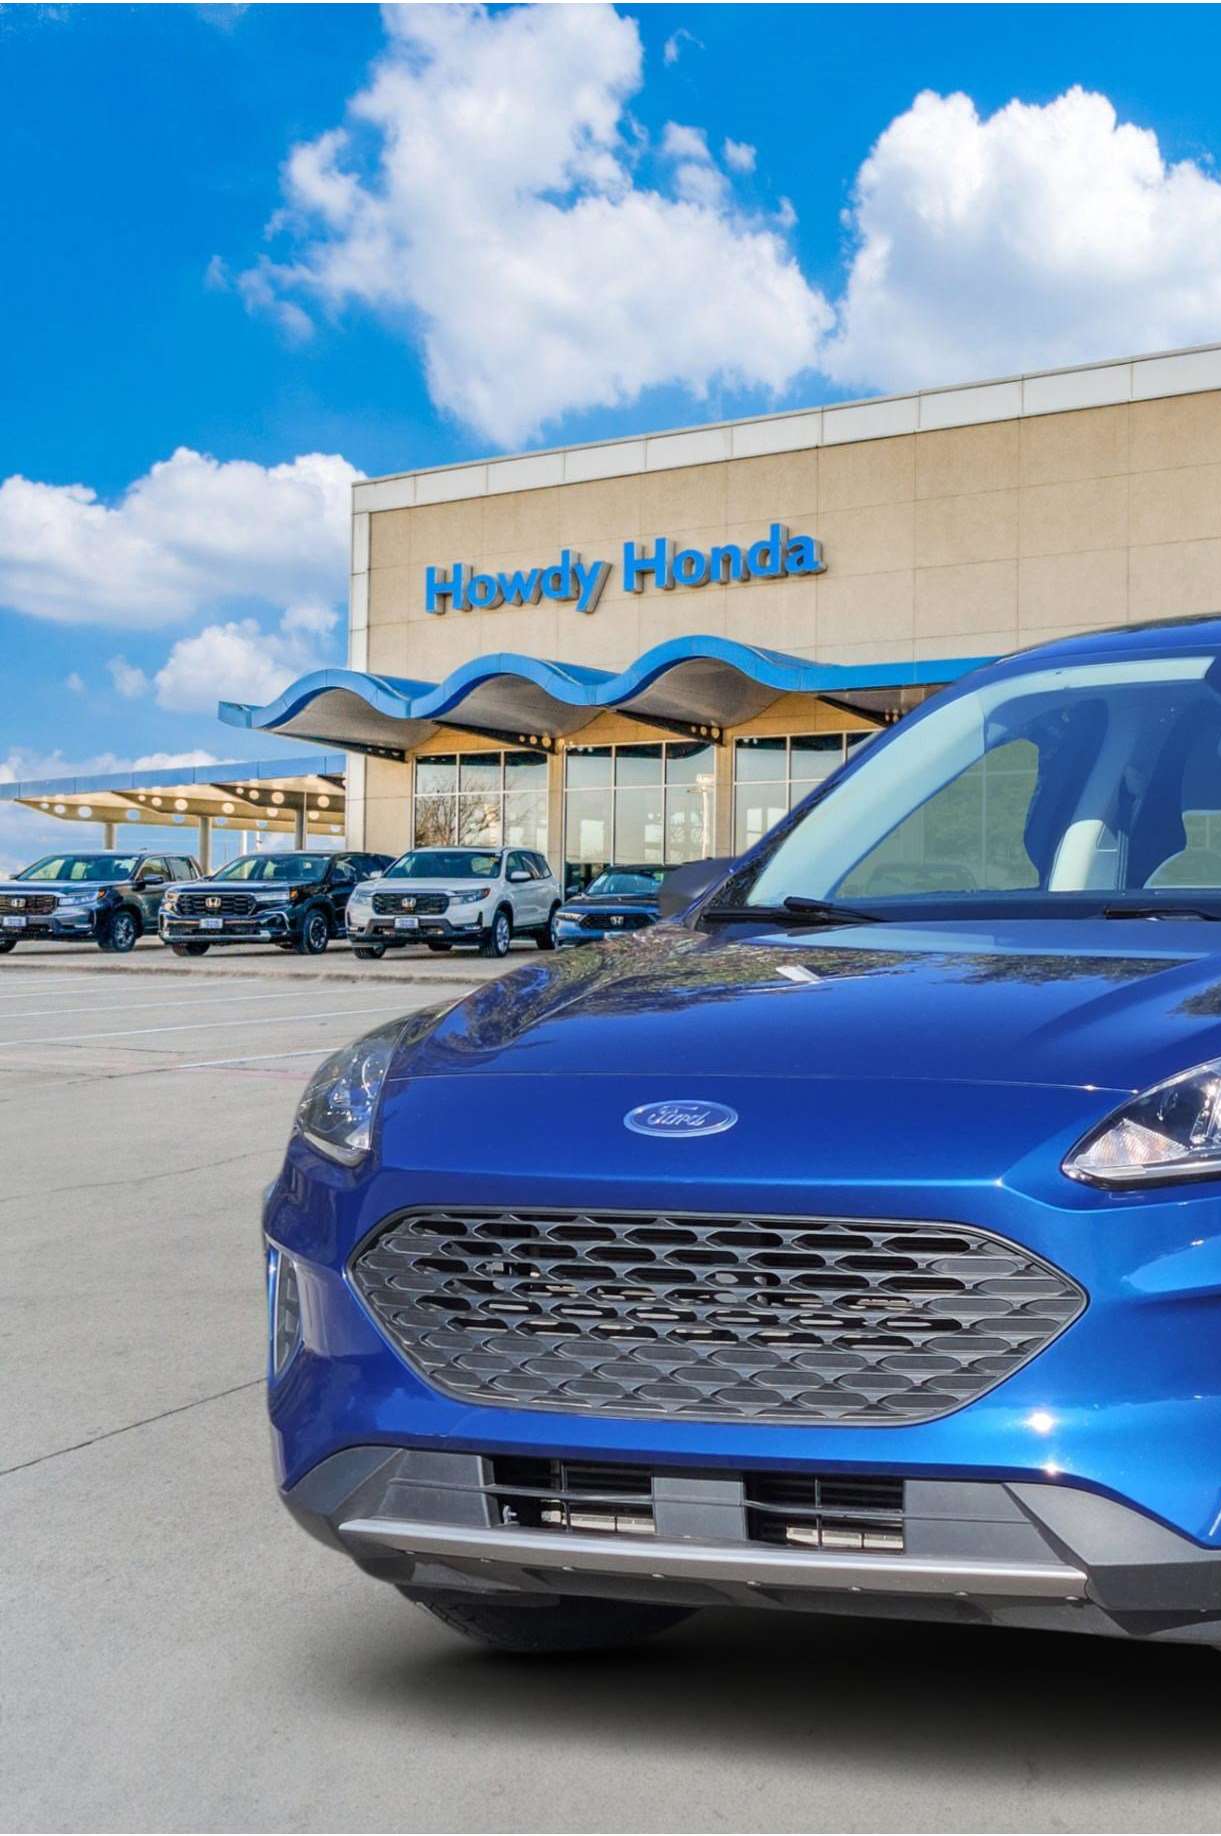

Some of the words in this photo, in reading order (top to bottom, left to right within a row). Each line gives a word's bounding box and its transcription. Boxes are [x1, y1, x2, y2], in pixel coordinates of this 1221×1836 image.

[425, 549, 611, 615] Howdy
[623, 523, 825, 594] Honda
[647, 1104, 711, 1126] Ford
